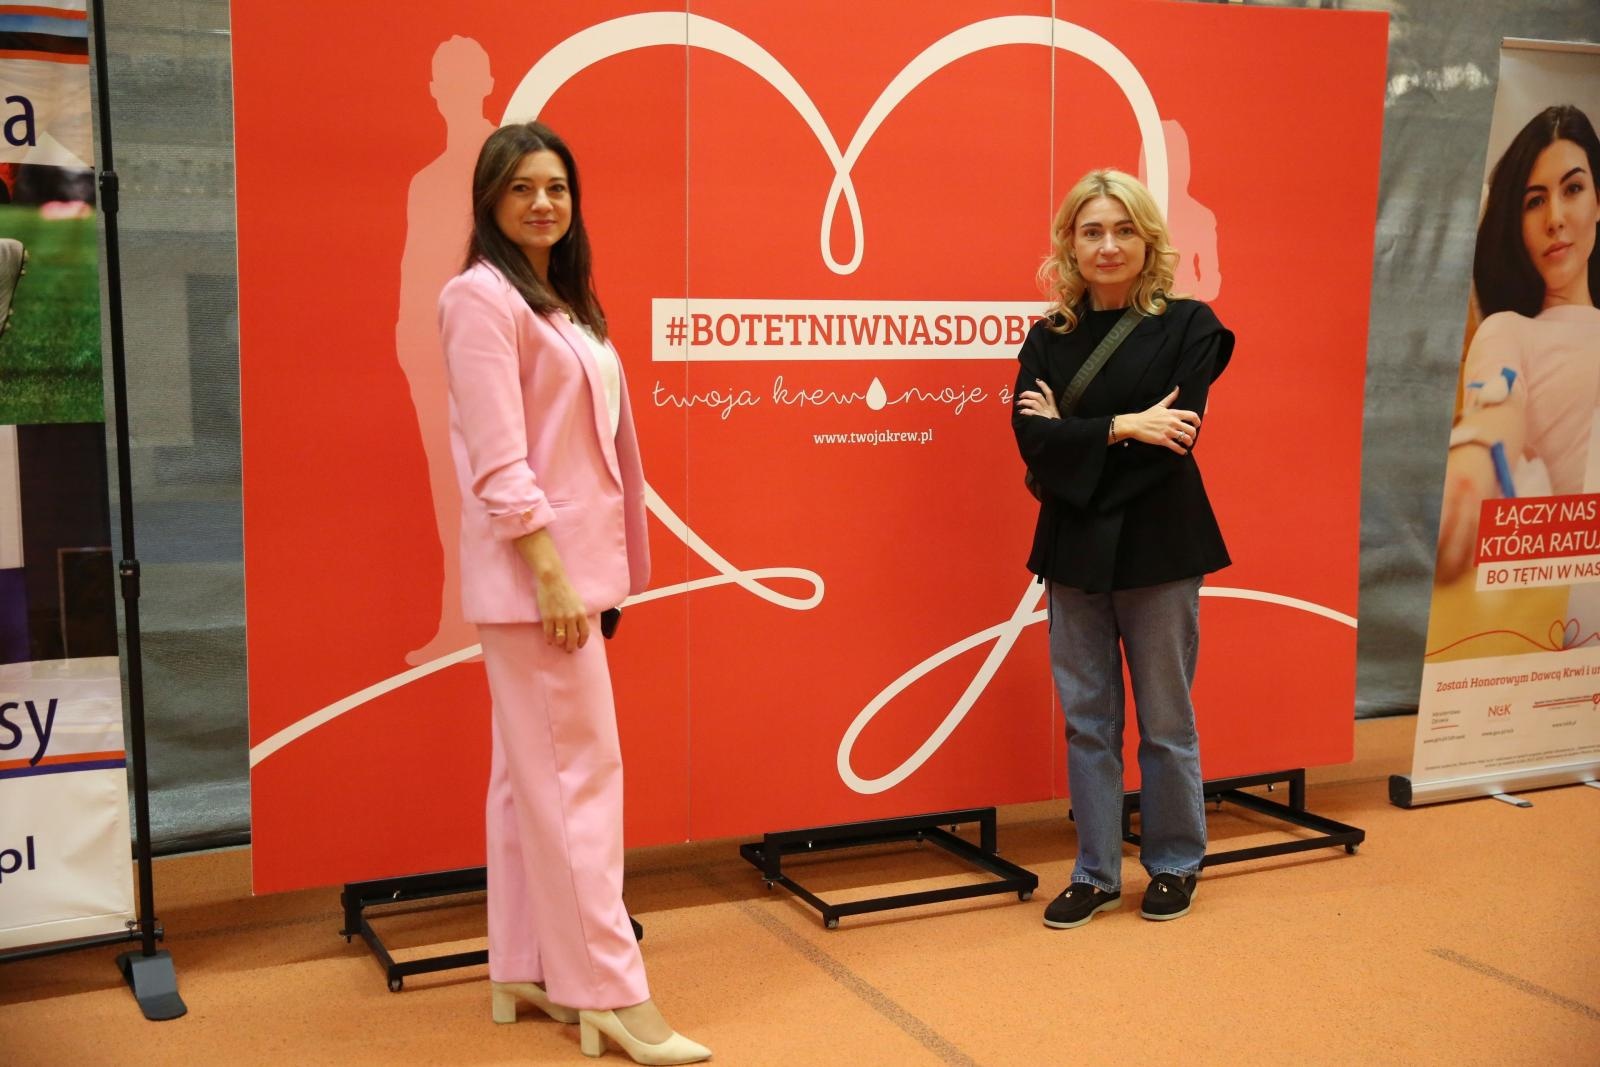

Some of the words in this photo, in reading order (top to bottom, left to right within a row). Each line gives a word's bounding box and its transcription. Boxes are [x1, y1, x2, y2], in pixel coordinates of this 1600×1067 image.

[652, 380, 760, 420] twoja
[773, 375, 865, 407] krew
[887, 385, 988, 415] moje
[813, 429, 933, 446] www.twojakrew.pl
[1495, 503, 1557, 529] ŁĄCZY
[1559, 500, 1597, 522] NAS
[1480, 530, 1545, 557] KTÓRA
[1486, 569, 1509, 585] BO
[1512, 565, 1553, 584] TĘTNI
[1557, 564, 1572, 578] W
[1436, 678, 1468, 692] Zostań
[1470, 673, 1529, 688] Honorowym
[1531, 669, 1562, 682] Dawcą
[1563, 665, 1585, 678] Krwi
